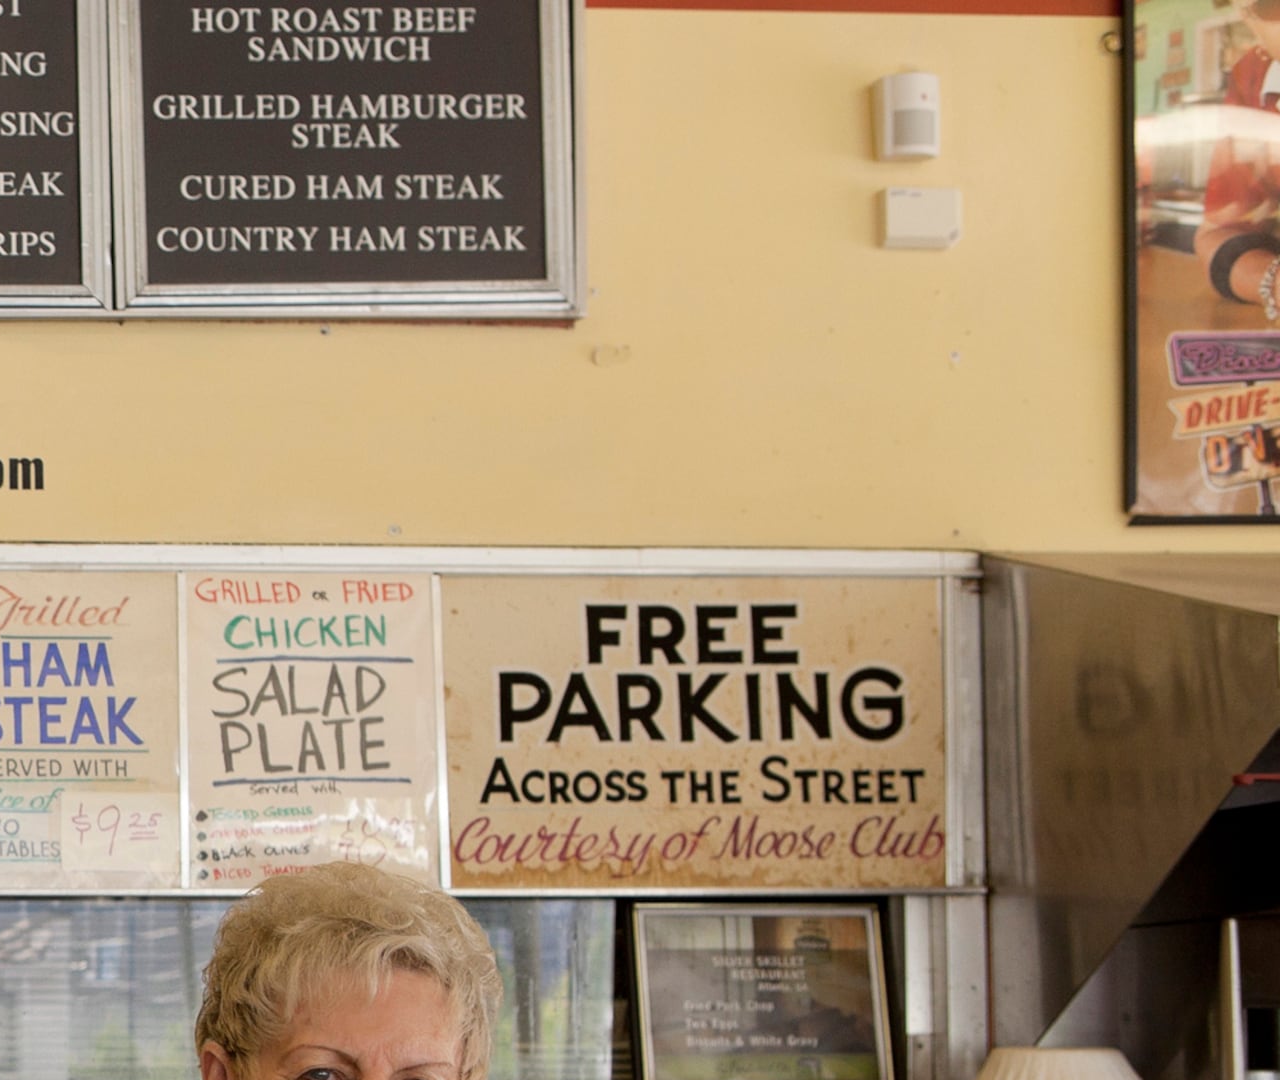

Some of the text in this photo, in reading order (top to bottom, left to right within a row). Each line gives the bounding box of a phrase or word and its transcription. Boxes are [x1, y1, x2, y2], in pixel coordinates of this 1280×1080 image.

[157, 226, 526, 251] COUNTRY HAM STEAK
[224, 615, 386, 650] CHICKEN
[586, 605, 798, 665] FREE
[2, 642, 114, 687] HAM
[212, 664, 385, 718] SALAD
[499, 668, 904, 743] PARKING
[220, 717, 390, 773] PLATE
[454, 814, 945, 879] Courtesy of Moose Club
